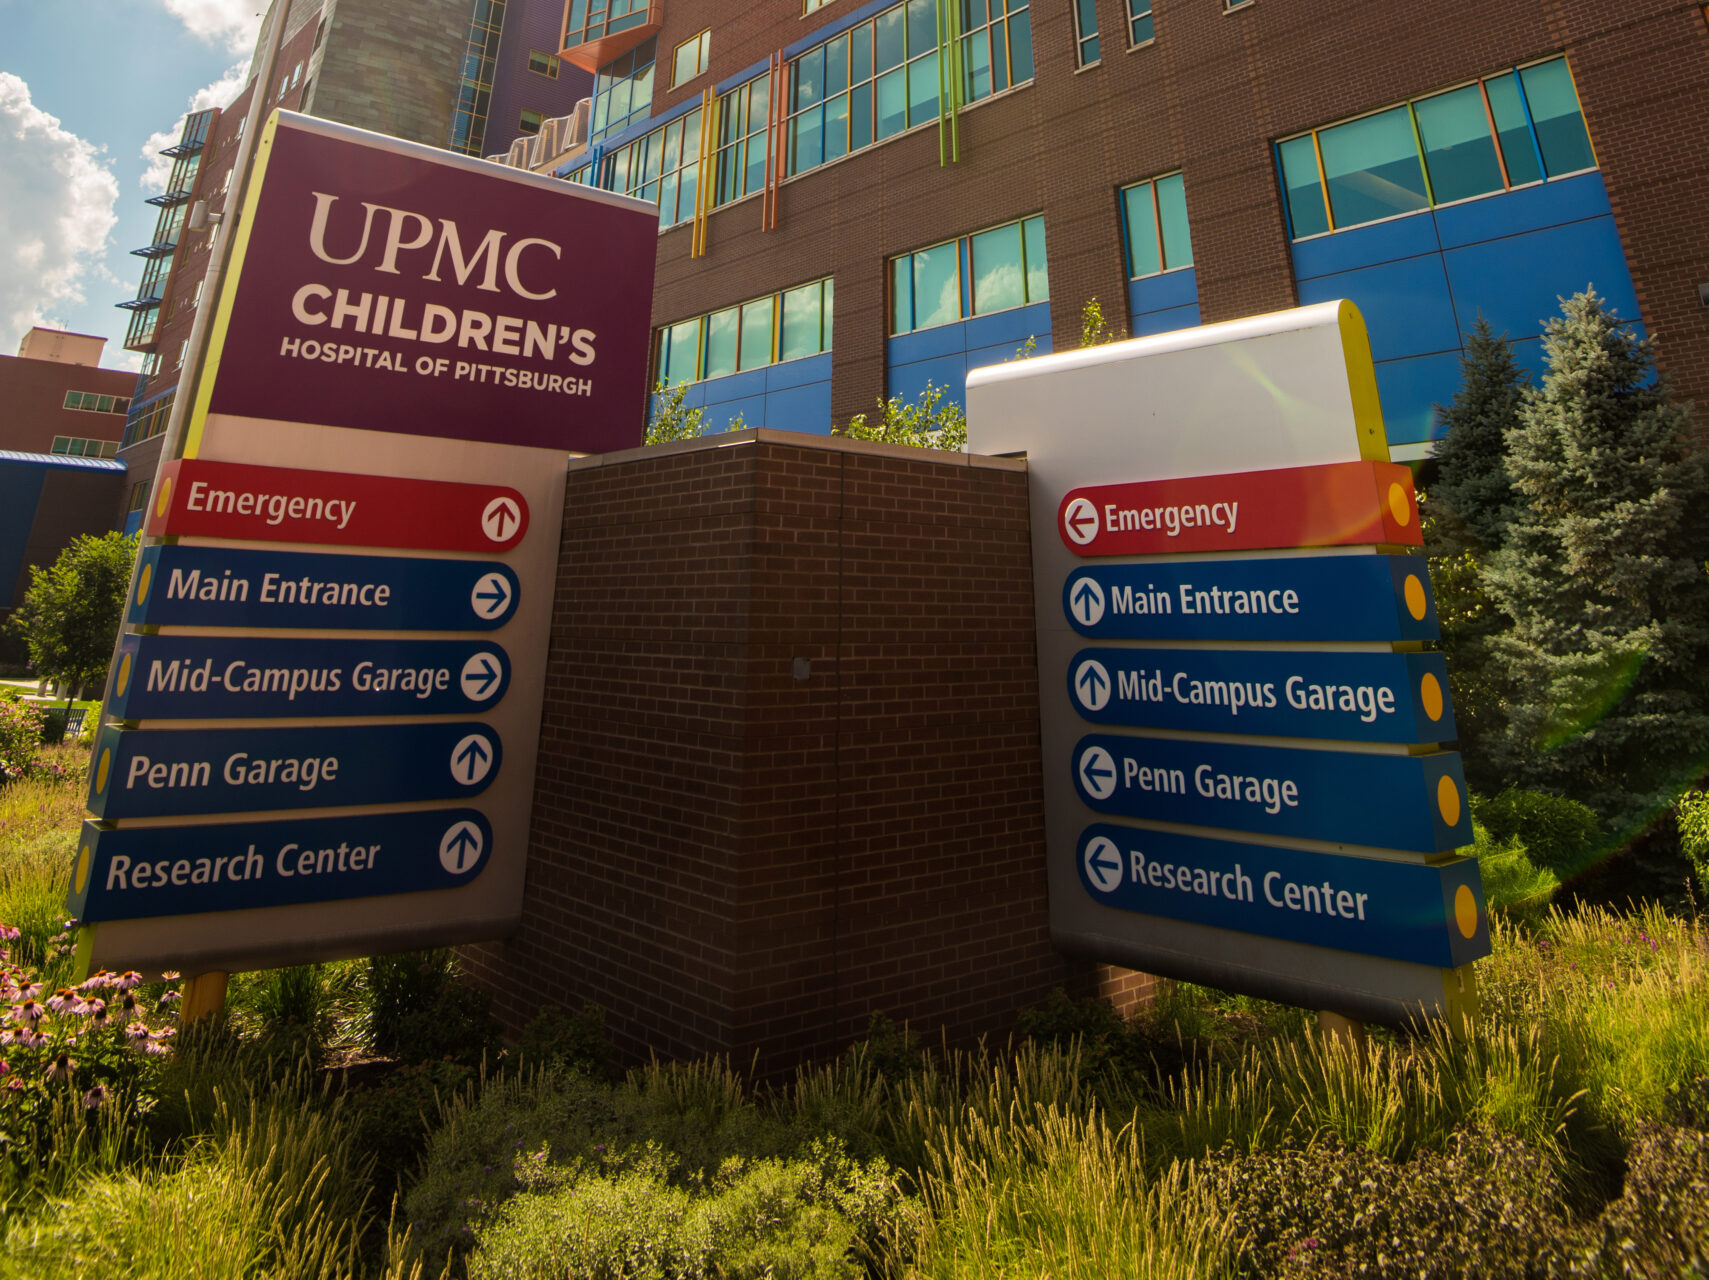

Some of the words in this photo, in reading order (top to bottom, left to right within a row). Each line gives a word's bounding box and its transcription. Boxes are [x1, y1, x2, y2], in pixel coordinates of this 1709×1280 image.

[310, 192, 561, 300] UPMC
[291, 283, 596, 366] CHILDREN'S
[280, 336, 408, 373] HOSPITAL
[415, 356, 450, 377] OF
[454, 361, 592, 397] PITTSBURGH
[187, 481, 356, 529] Emergency
[1104, 501, 1239, 537] Emergency
[167, 568, 249, 602] Main
[260, 573, 390, 606] Entrance
[1111, 583, 1172, 614] Main
[1179, 584, 1299, 614] Entrance
[147, 658, 342, 700] Mid-Campus
[352, 661, 449, 699] Garage
[1118, 669, 1277, 715] Mid-Campus
[1285, 675, 1395, 723] Garage
[127, 755, 211, 789] Penn
[224, 752, 338, 790] Garage
[1124, 757, 1185, 794] Penn
[1195, 764, 1298, 814] Garage
[106, 844, 264, 890] Research
[276, 842, 381, 876] Center
[1130, 851, 1254, 902] Research
[1263, 871, 1368, 921] Center
